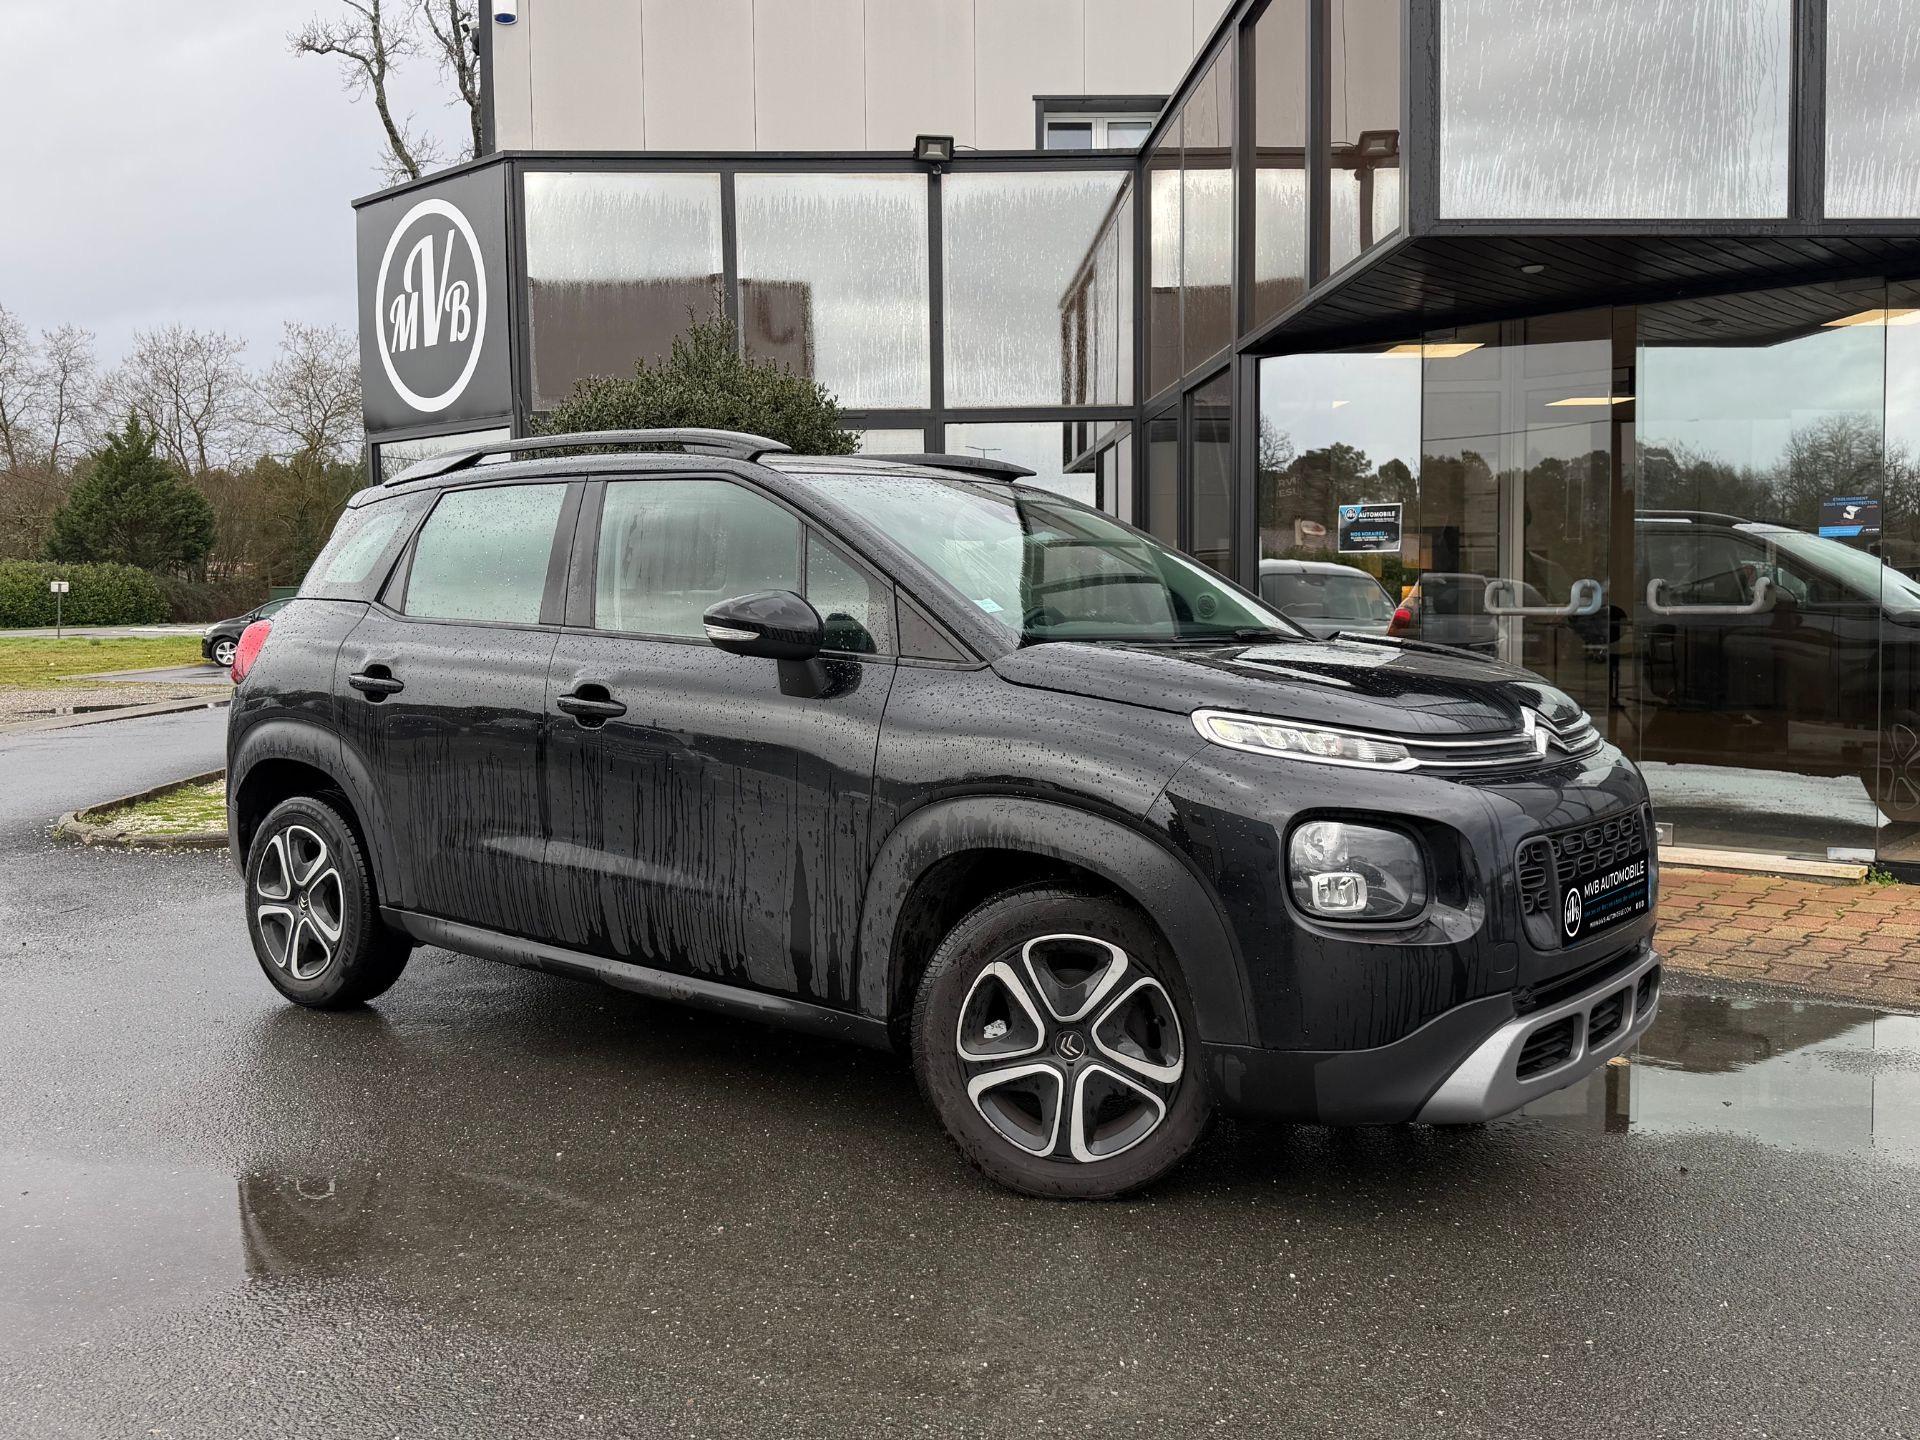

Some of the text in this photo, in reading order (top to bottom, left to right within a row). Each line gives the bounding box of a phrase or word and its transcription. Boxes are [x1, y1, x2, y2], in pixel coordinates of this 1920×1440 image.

[390, 229, 471, 353] MVB
[1359, 510, 1395, 518] AUTOMOBILE
[1584, 860, 1645, 898] MVB AUTOMOBILE
[1567, 894, 1580, 924] MVB
